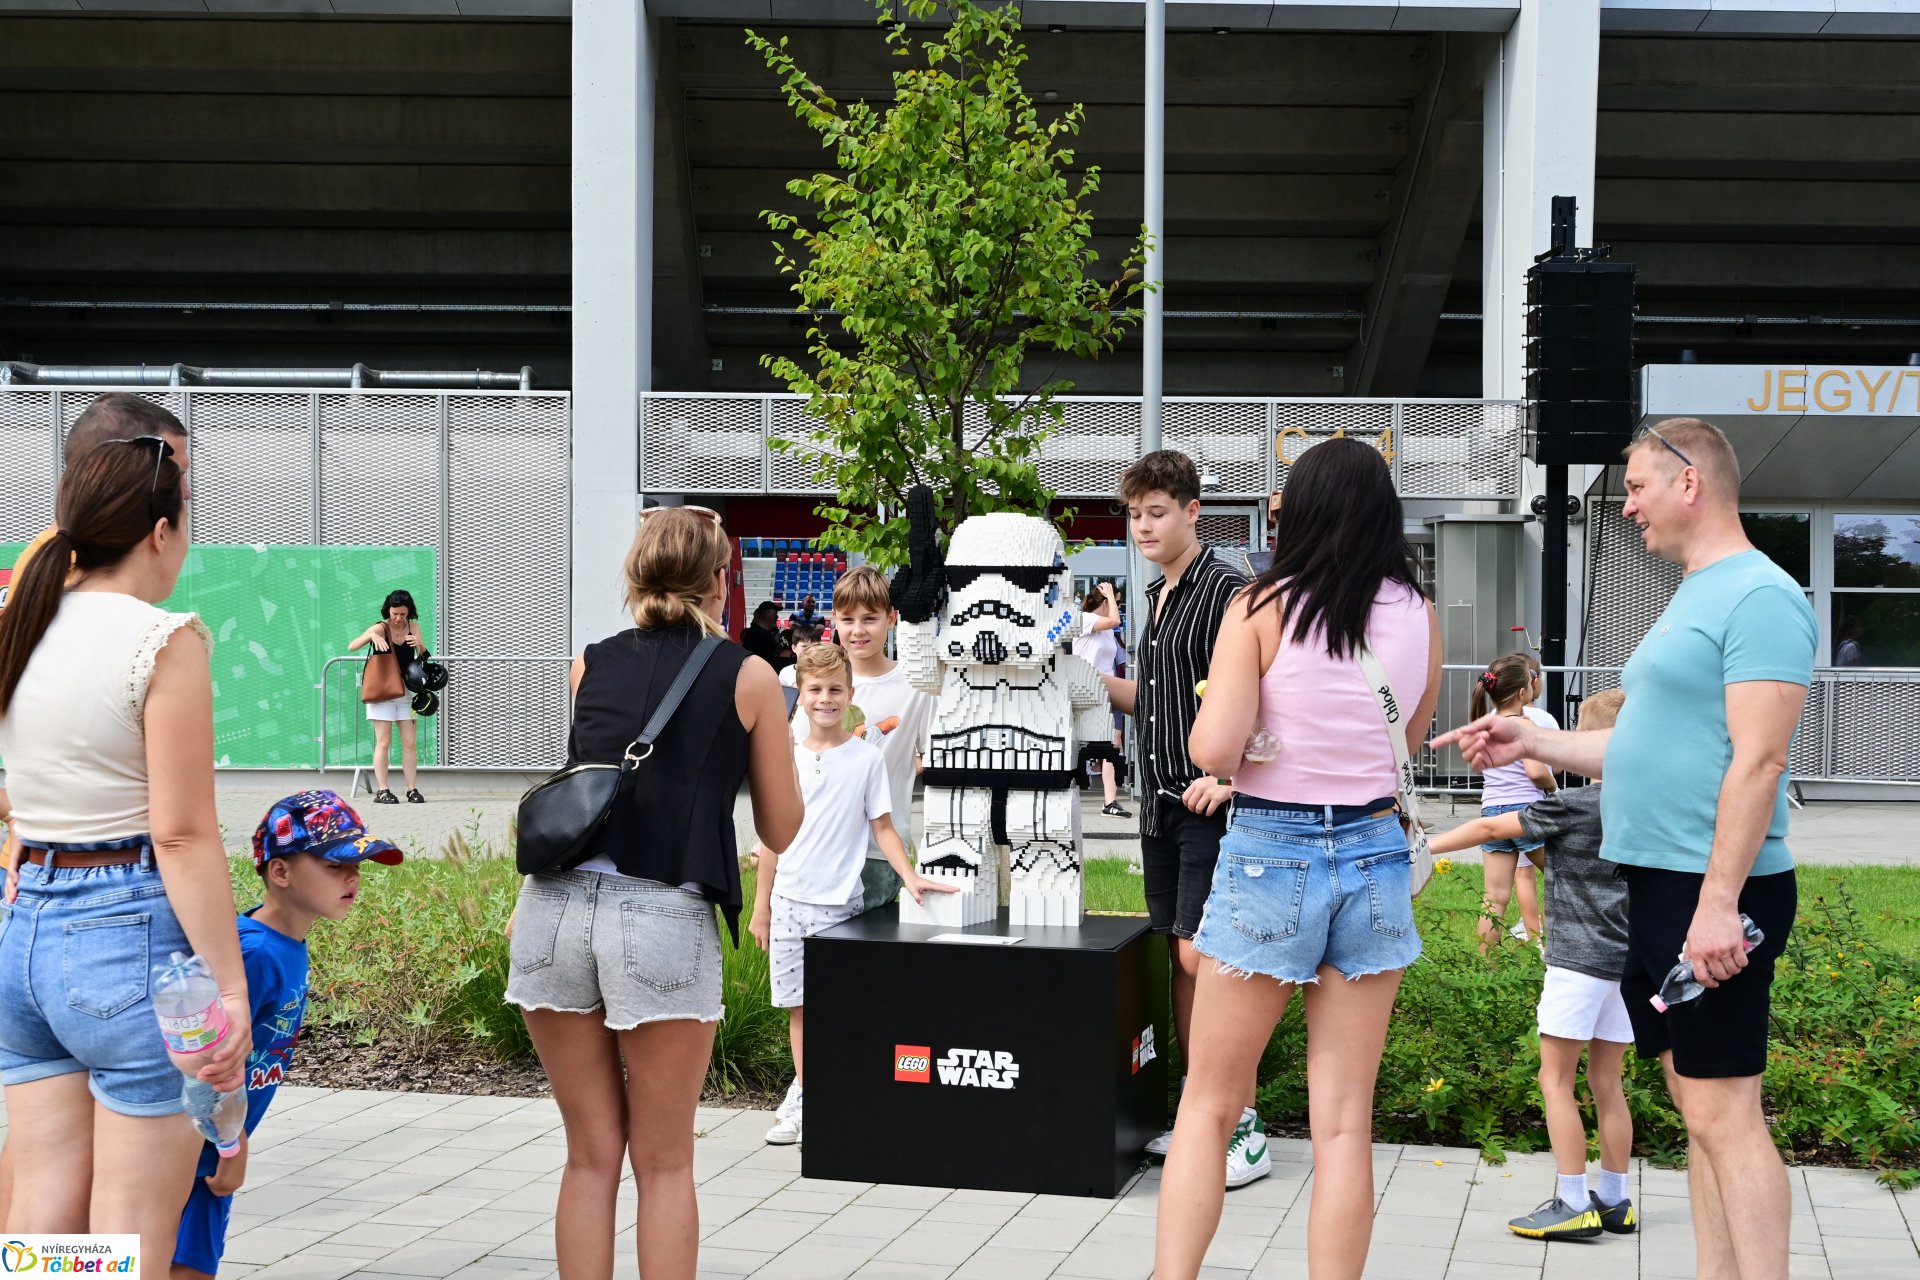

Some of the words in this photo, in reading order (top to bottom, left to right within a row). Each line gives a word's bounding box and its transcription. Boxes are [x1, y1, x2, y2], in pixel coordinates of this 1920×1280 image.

[1378, 684, 1399, 724] Chloé
[897, 1056, 930, 1073] LEGO
[936, 1048, 1020, 1071] STAR
[937, 1065, 1020, 1089] WARS
